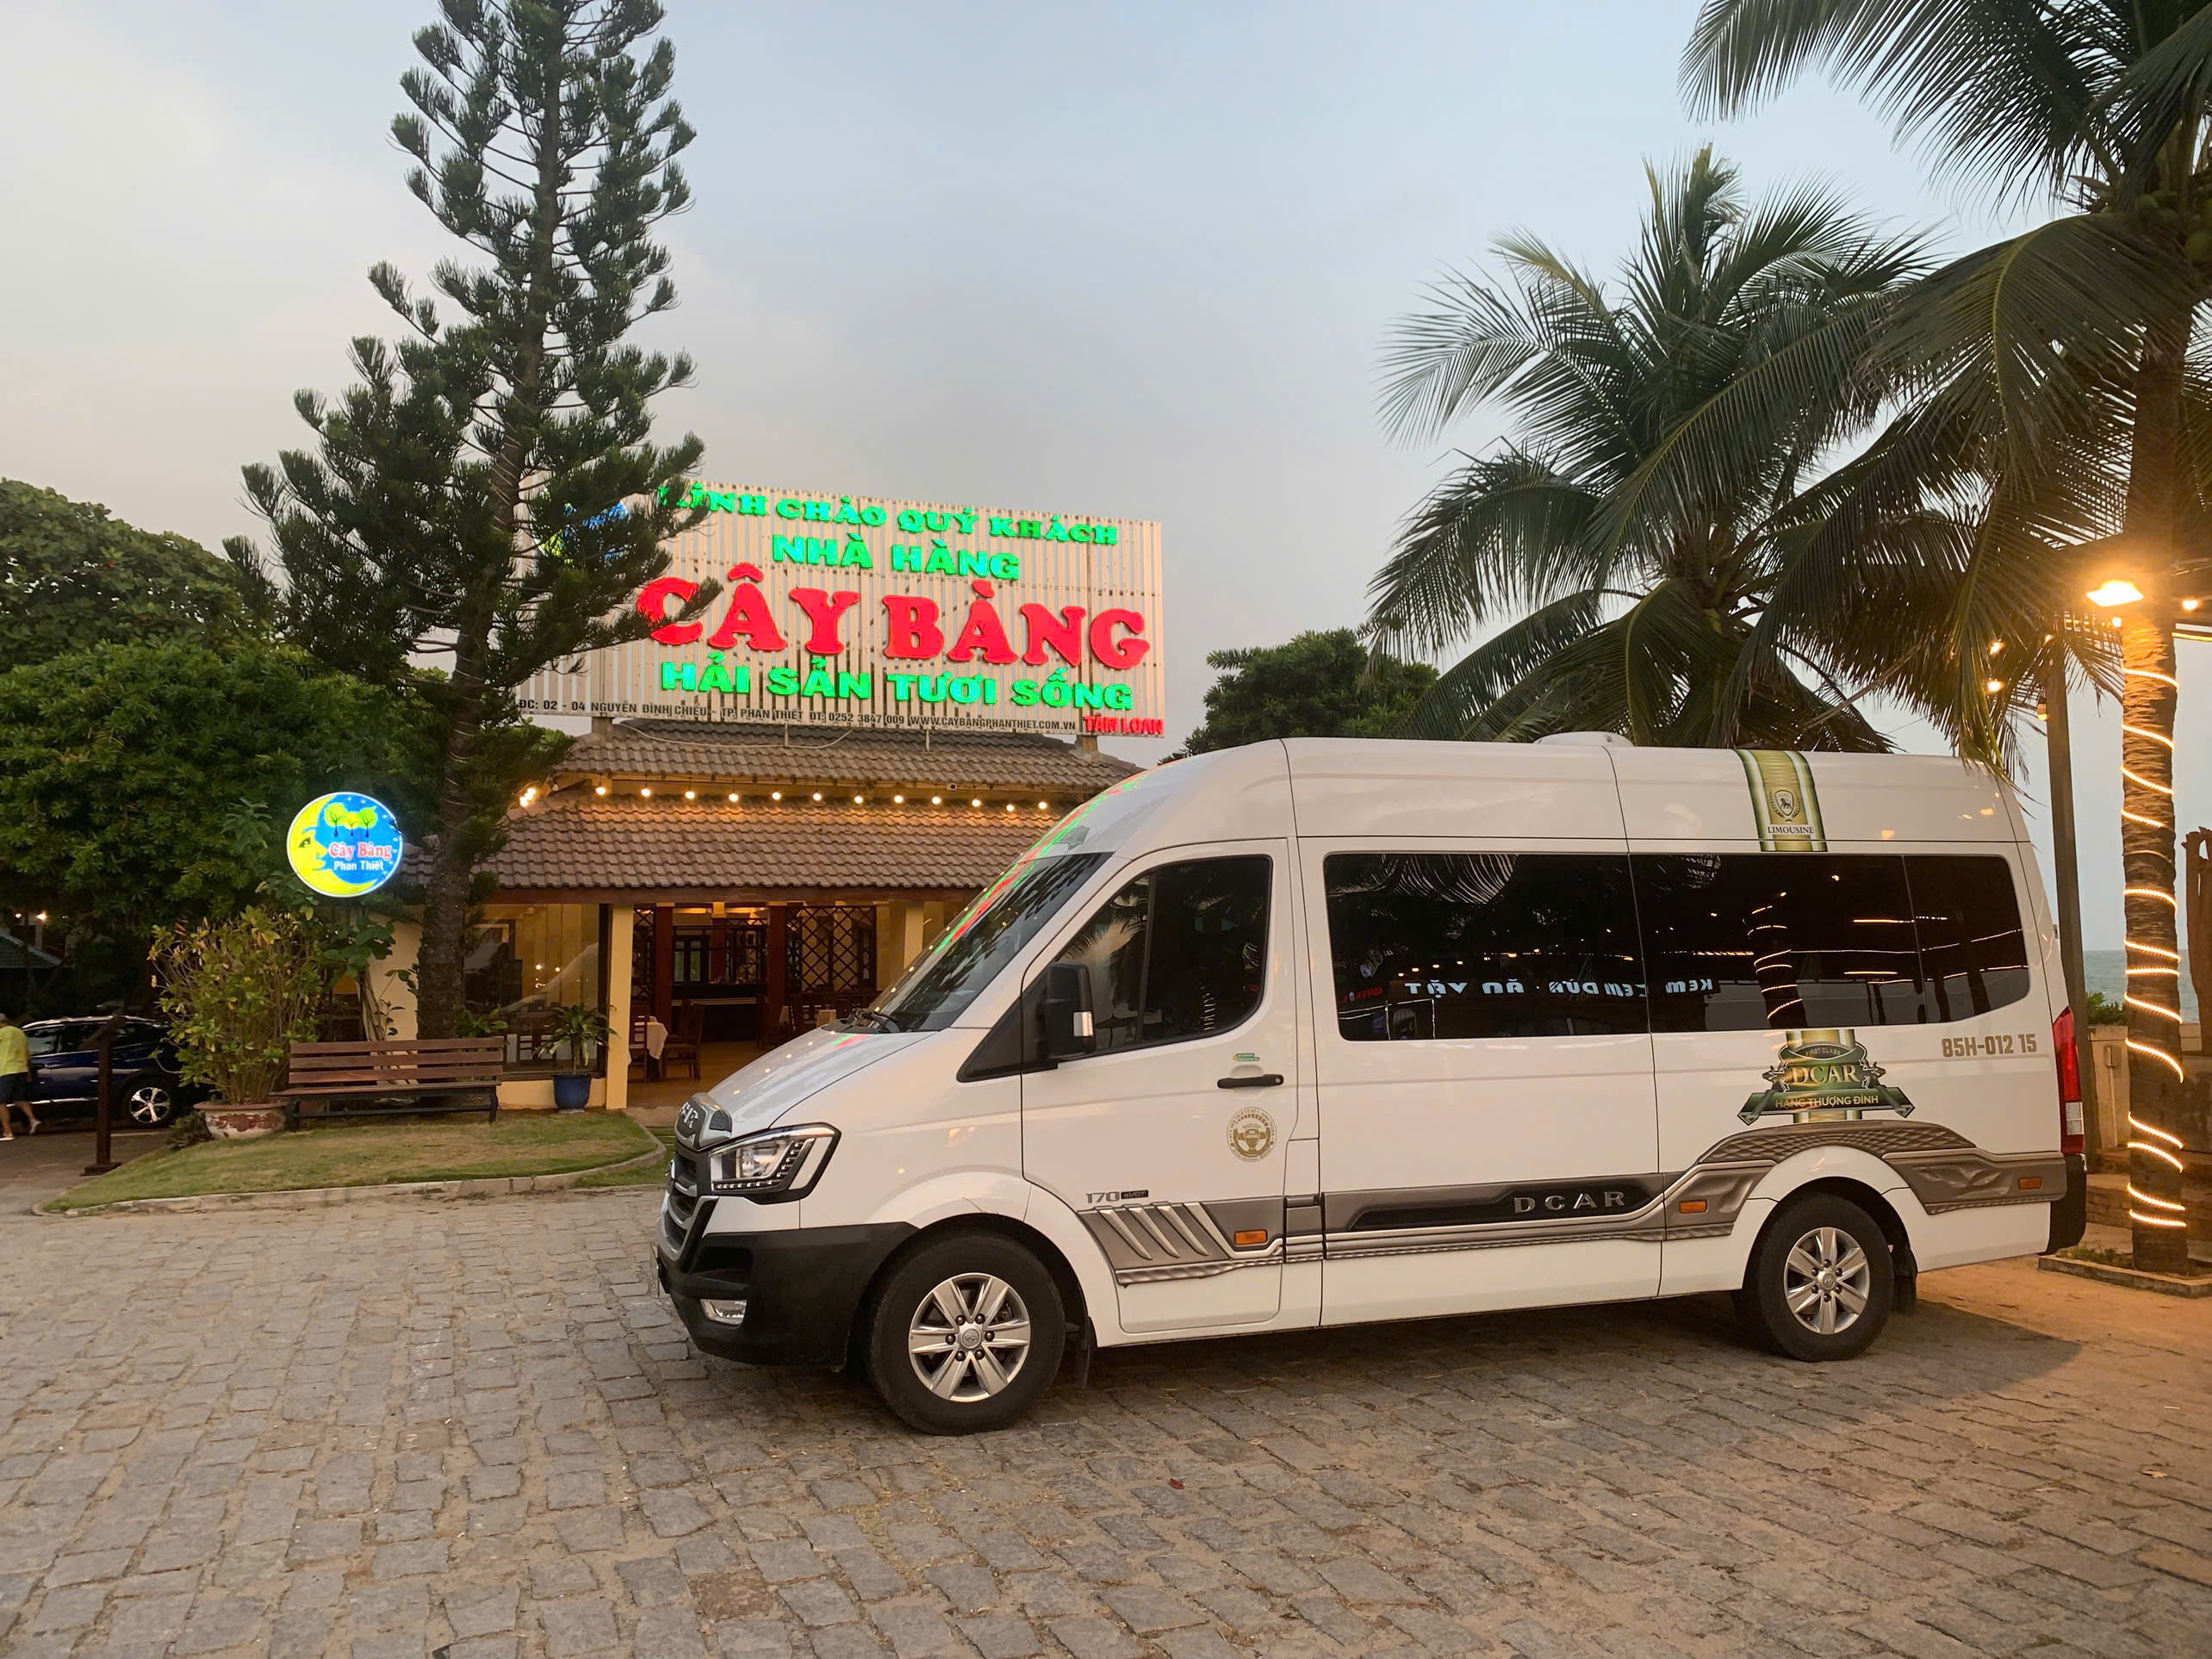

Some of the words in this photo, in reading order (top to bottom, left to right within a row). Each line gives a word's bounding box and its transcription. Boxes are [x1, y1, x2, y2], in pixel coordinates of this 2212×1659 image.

[898, 506, 979, 534] QUÝ
[989, 514, 1118, 545] KHÁCH
[772, 532, 873, 569] NHÀ
[892, 538, 1021, 581] HÀNG
[637, 562, 861, 656] CÂY
[882, 579, 1151, 670] BÀNG
[661, 651, 750, 694] HẢI
[766, 657, 871, 699] SẢN
[886, 671, 997, 705] TƯƠI
[1011, 668, 1133, 710] SỐNG
[544, 699, 557, 710] 02
[572, 701, 586, 711] 04
[740, 708, 770, 719] PHAN
[829, 711, 854, 723] 0252
[857, 712, 881, 724] 3847
[886, 715, 904, 724] 009
[329, 841, 354, 860] Cây
[358, 841, 392, 860] Bàng
[334, 860, 357, 871] Phan
[360, 860, 384, 871] Thiết
[1805, 1047, 1821, 1057] FIRST
[1822, 1047, 1841, 1056] CLASS
[1791, 1064, 1861, 1084] DCAR
[1085, 1191, 1120, 1204] 170
[1513, 1191, 1625, 1214] DCAR
